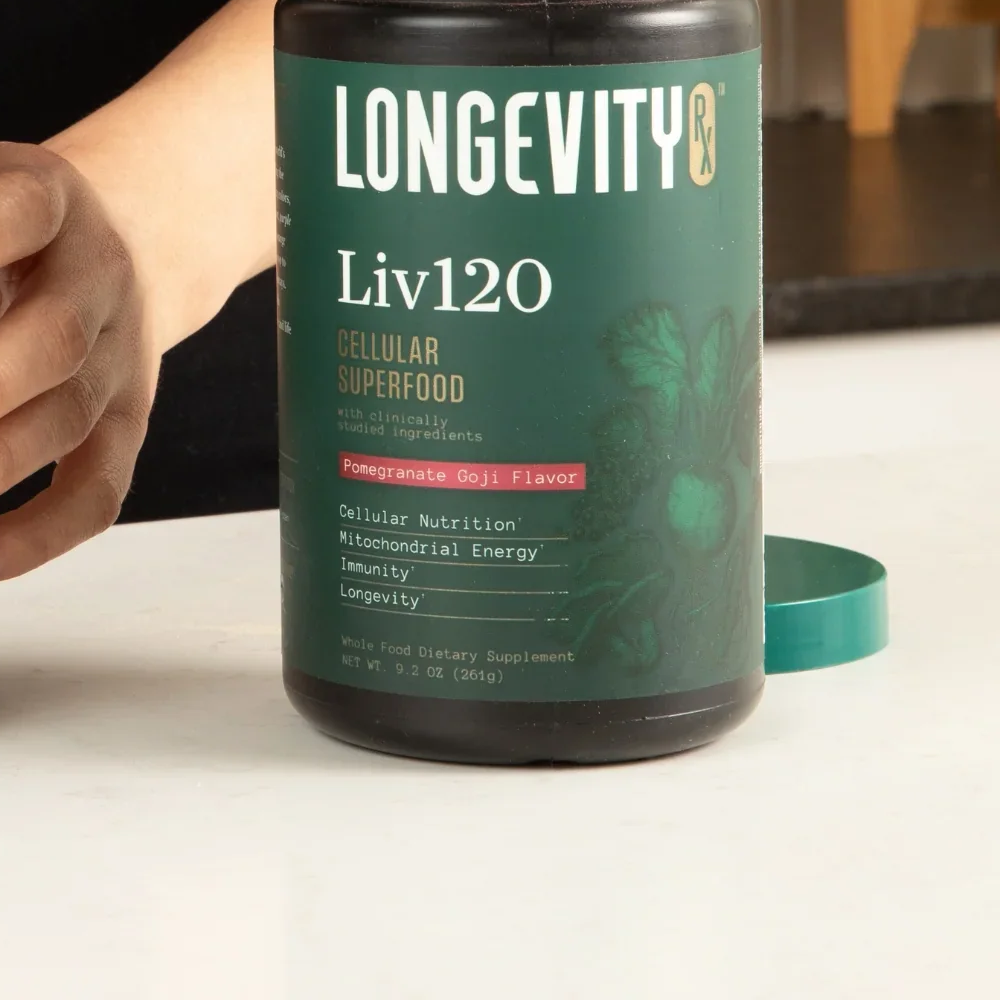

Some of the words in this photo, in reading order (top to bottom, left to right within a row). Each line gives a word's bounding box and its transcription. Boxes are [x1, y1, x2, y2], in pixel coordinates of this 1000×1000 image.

[336, 85, 682, 196] LONGEVITY
[338, 328, 439, 365] CELLULAR
[338, 366, 464, 403] SUPERFOOD
[338, 408, 363, 420] with
[370, 411, 448, 429] clinically
[338, 421, 384, 436] studied
[393, 427, 483, 442] ingredients
[344, 459, 446, 482] Pomegranate
[457, 470, 499, 487] Goji
[512, 470, 577, 484] Flavor
[340, 504, 408, 526] Cellular
[340, 531, 459, 557] Mitochondrial
[342, 635, 374, 651] Whole
[381, 642, 411, 656] Food
[419, 646, 477, 663] Dietary
[487, 651, 575, 664] Supplement
[342, 654, 360, 668] NET
[367, 660, 387, 673] WT.
[396, 663, 419, 676] 9.2
[427, 666, 443, 679] OZ
[453, 669, 504, 684] (261g)
